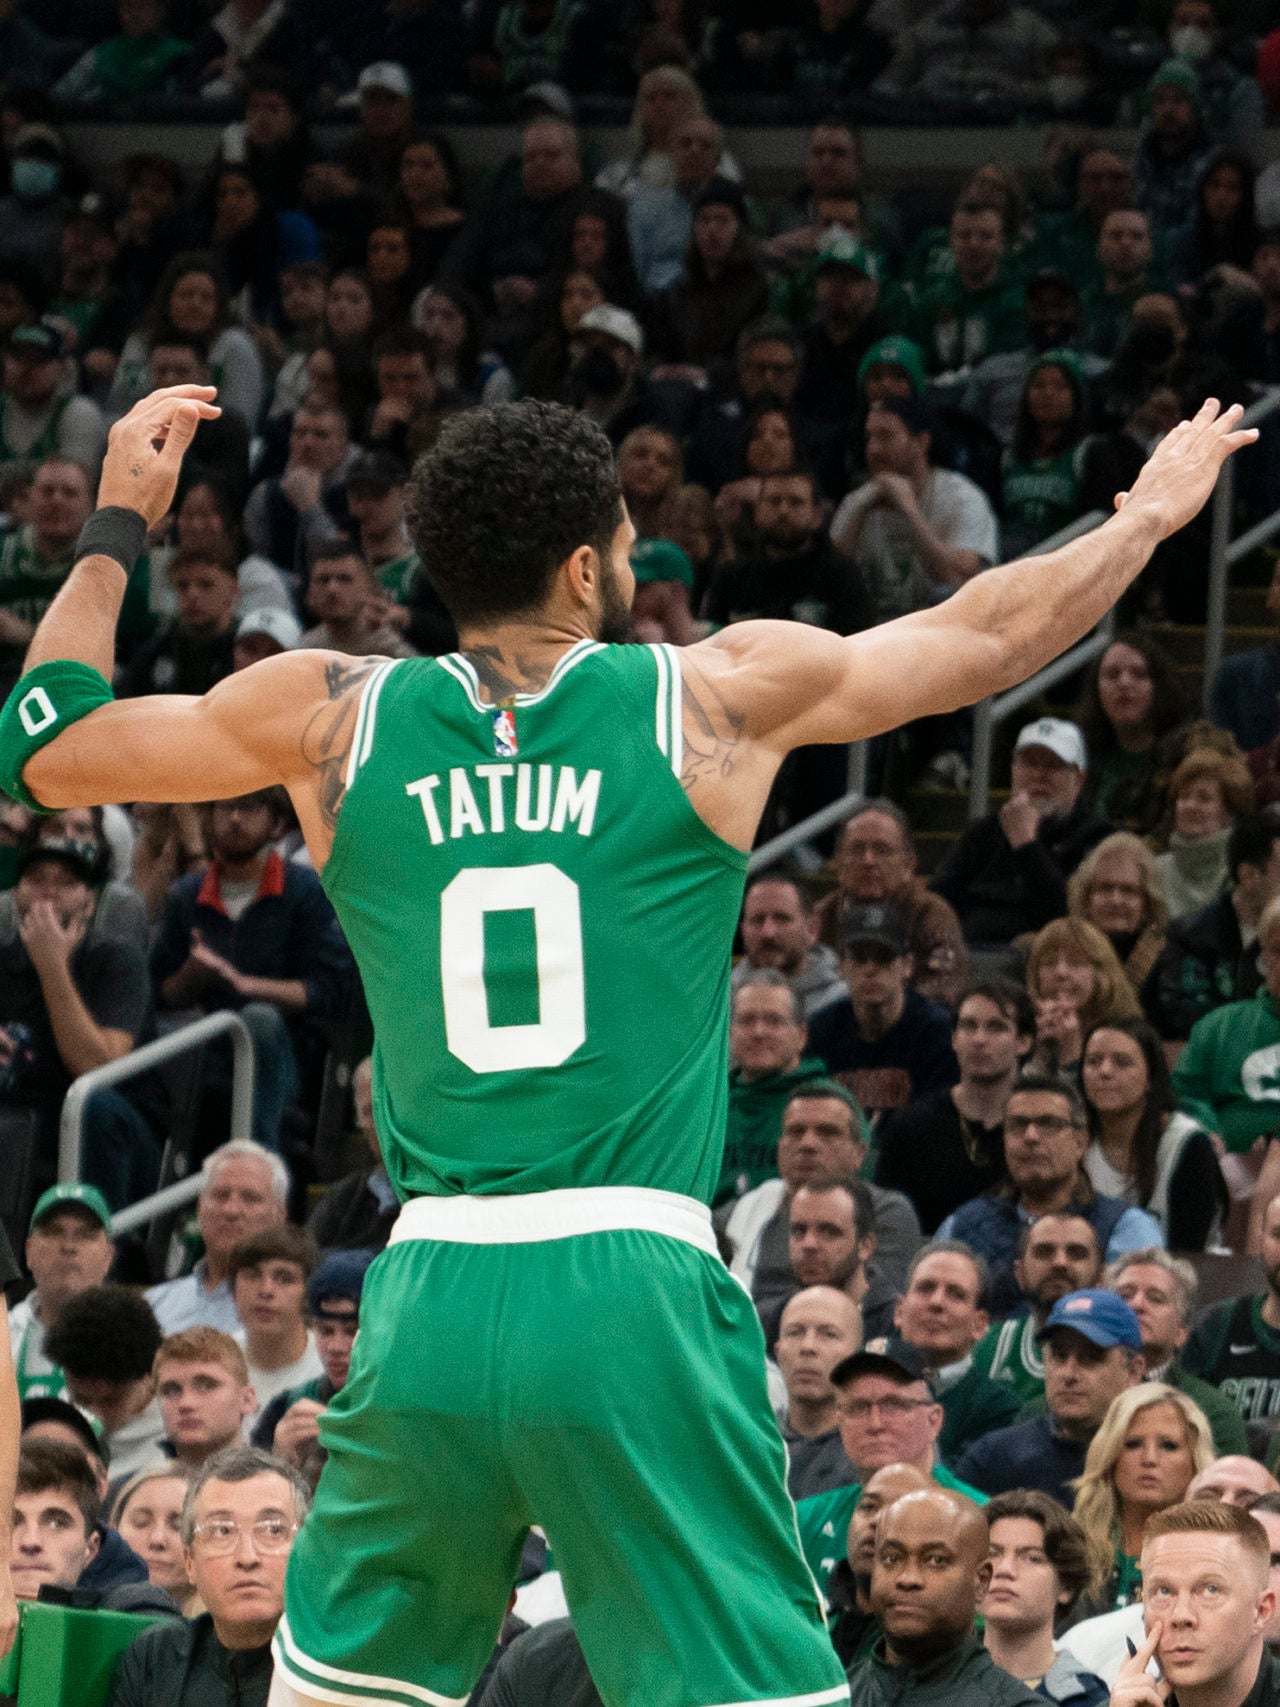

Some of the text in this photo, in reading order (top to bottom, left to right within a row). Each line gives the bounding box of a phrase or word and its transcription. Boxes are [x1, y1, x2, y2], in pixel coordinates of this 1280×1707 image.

[18, 686, 58, 737] 0
[406, 763, 602, 845] TATUM
[440, 862, 588, 1075] 0
